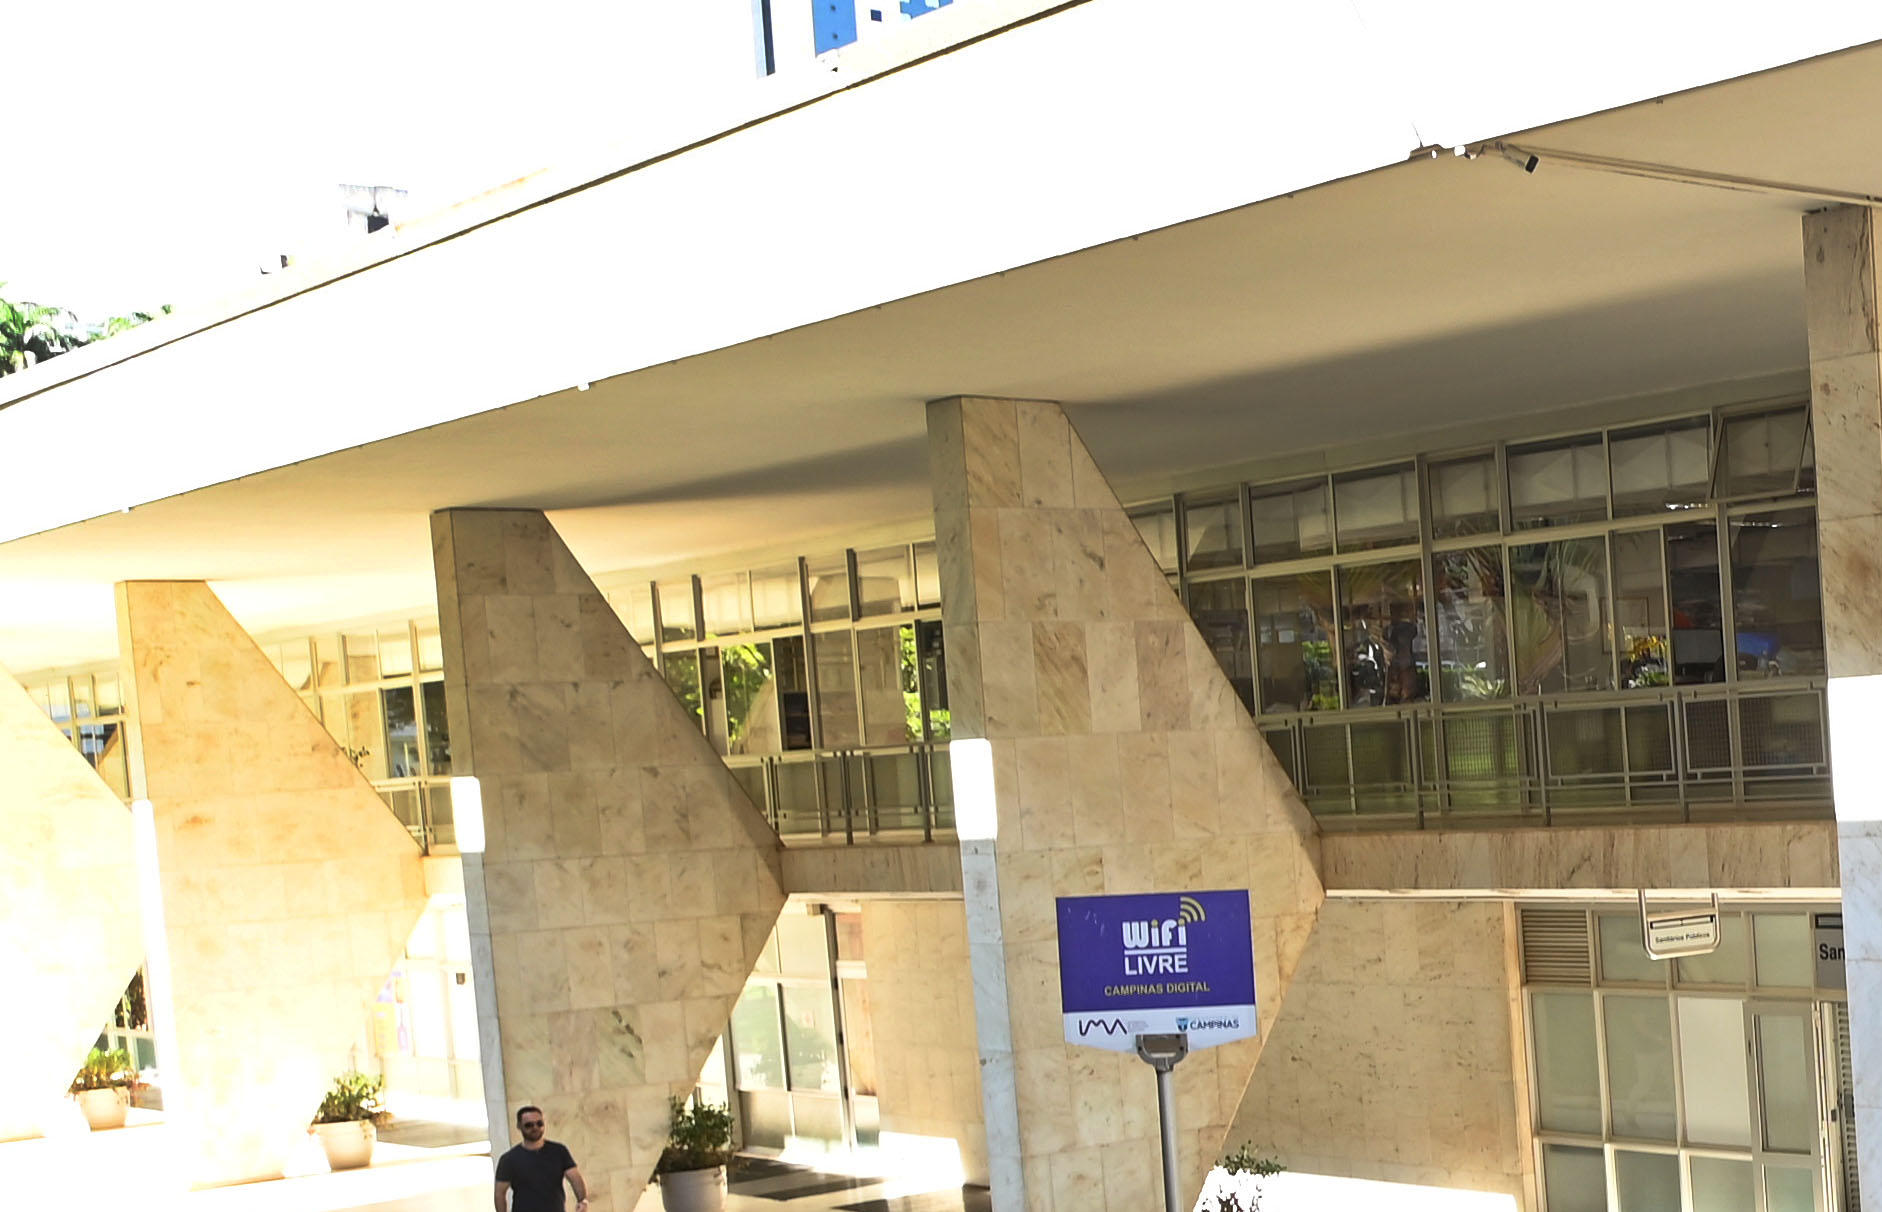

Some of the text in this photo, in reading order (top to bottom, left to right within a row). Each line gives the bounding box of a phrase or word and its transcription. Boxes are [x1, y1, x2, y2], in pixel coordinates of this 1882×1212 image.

[1124, 953, 1188, 976] LIVRE
[1104, 981, 1211, 997] CAMPINAS DIGITAL
[1189, 1018, 1240, 1031] CAMPINAS
